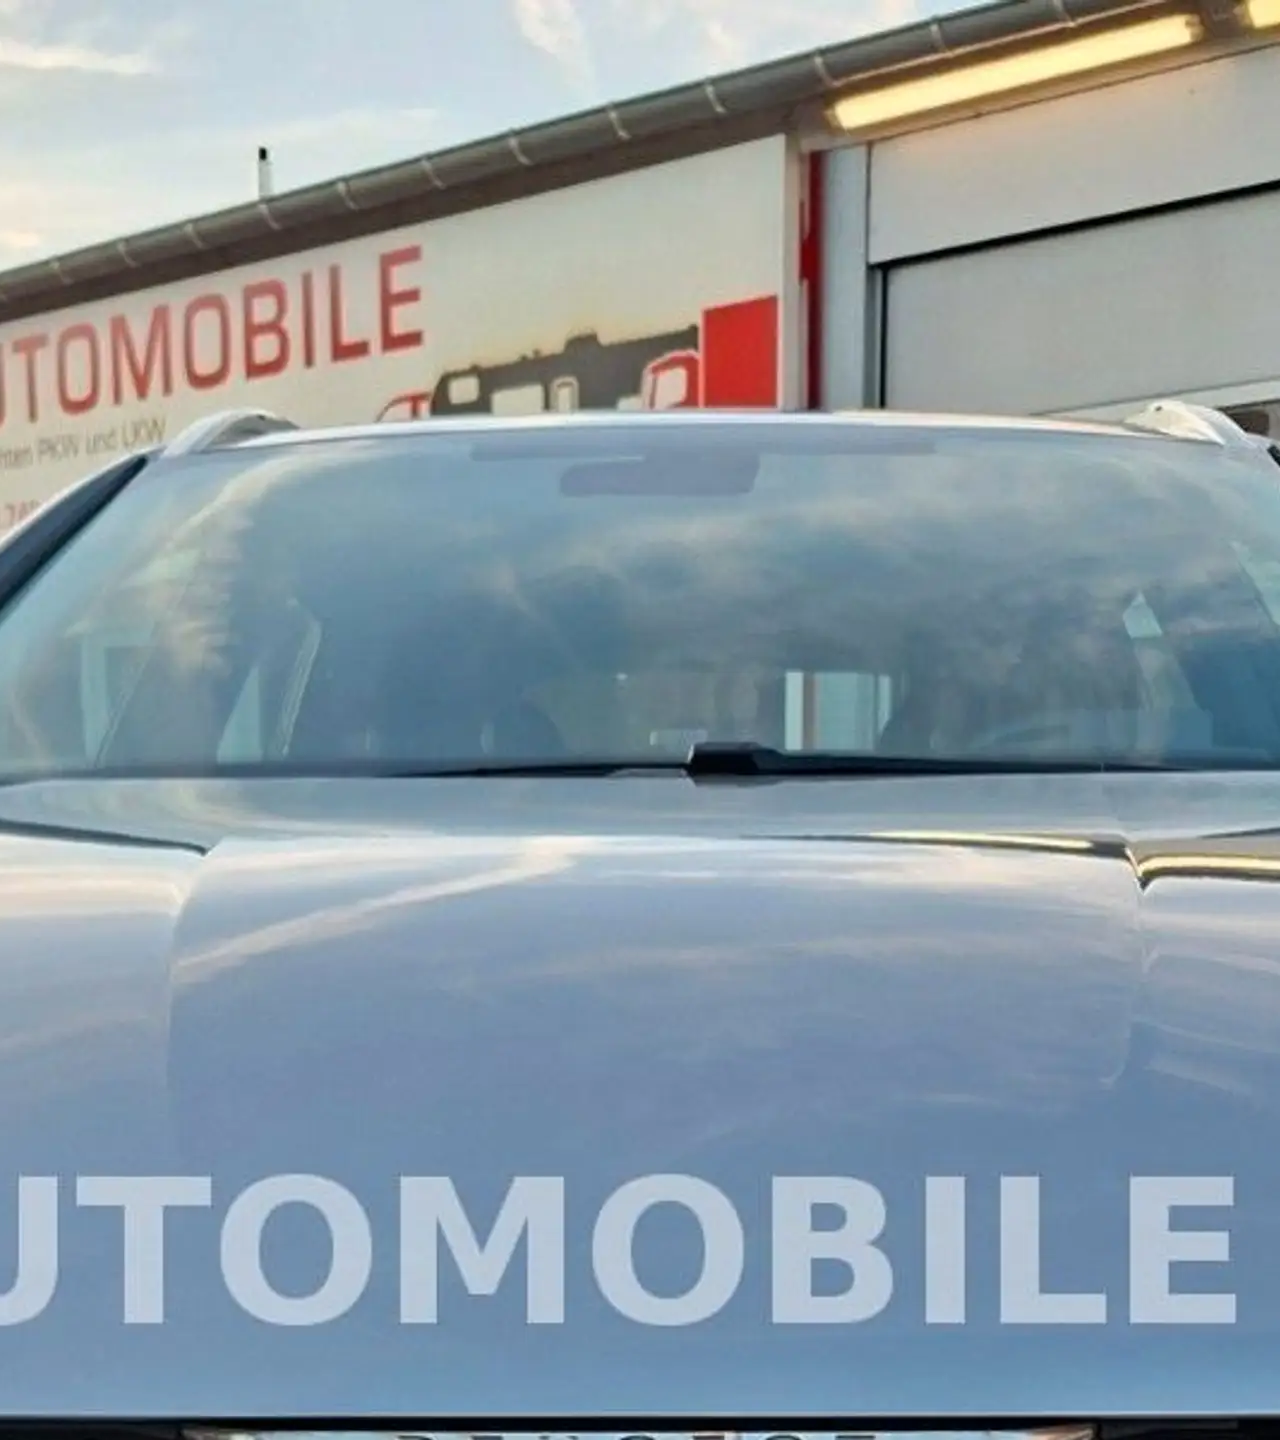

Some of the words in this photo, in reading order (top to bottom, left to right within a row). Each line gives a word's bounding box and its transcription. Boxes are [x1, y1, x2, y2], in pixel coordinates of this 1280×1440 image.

[37, 433, 81, 464] PKW
[86, 427, 117, 453] und
[122, 416, 167, 447] LKW
